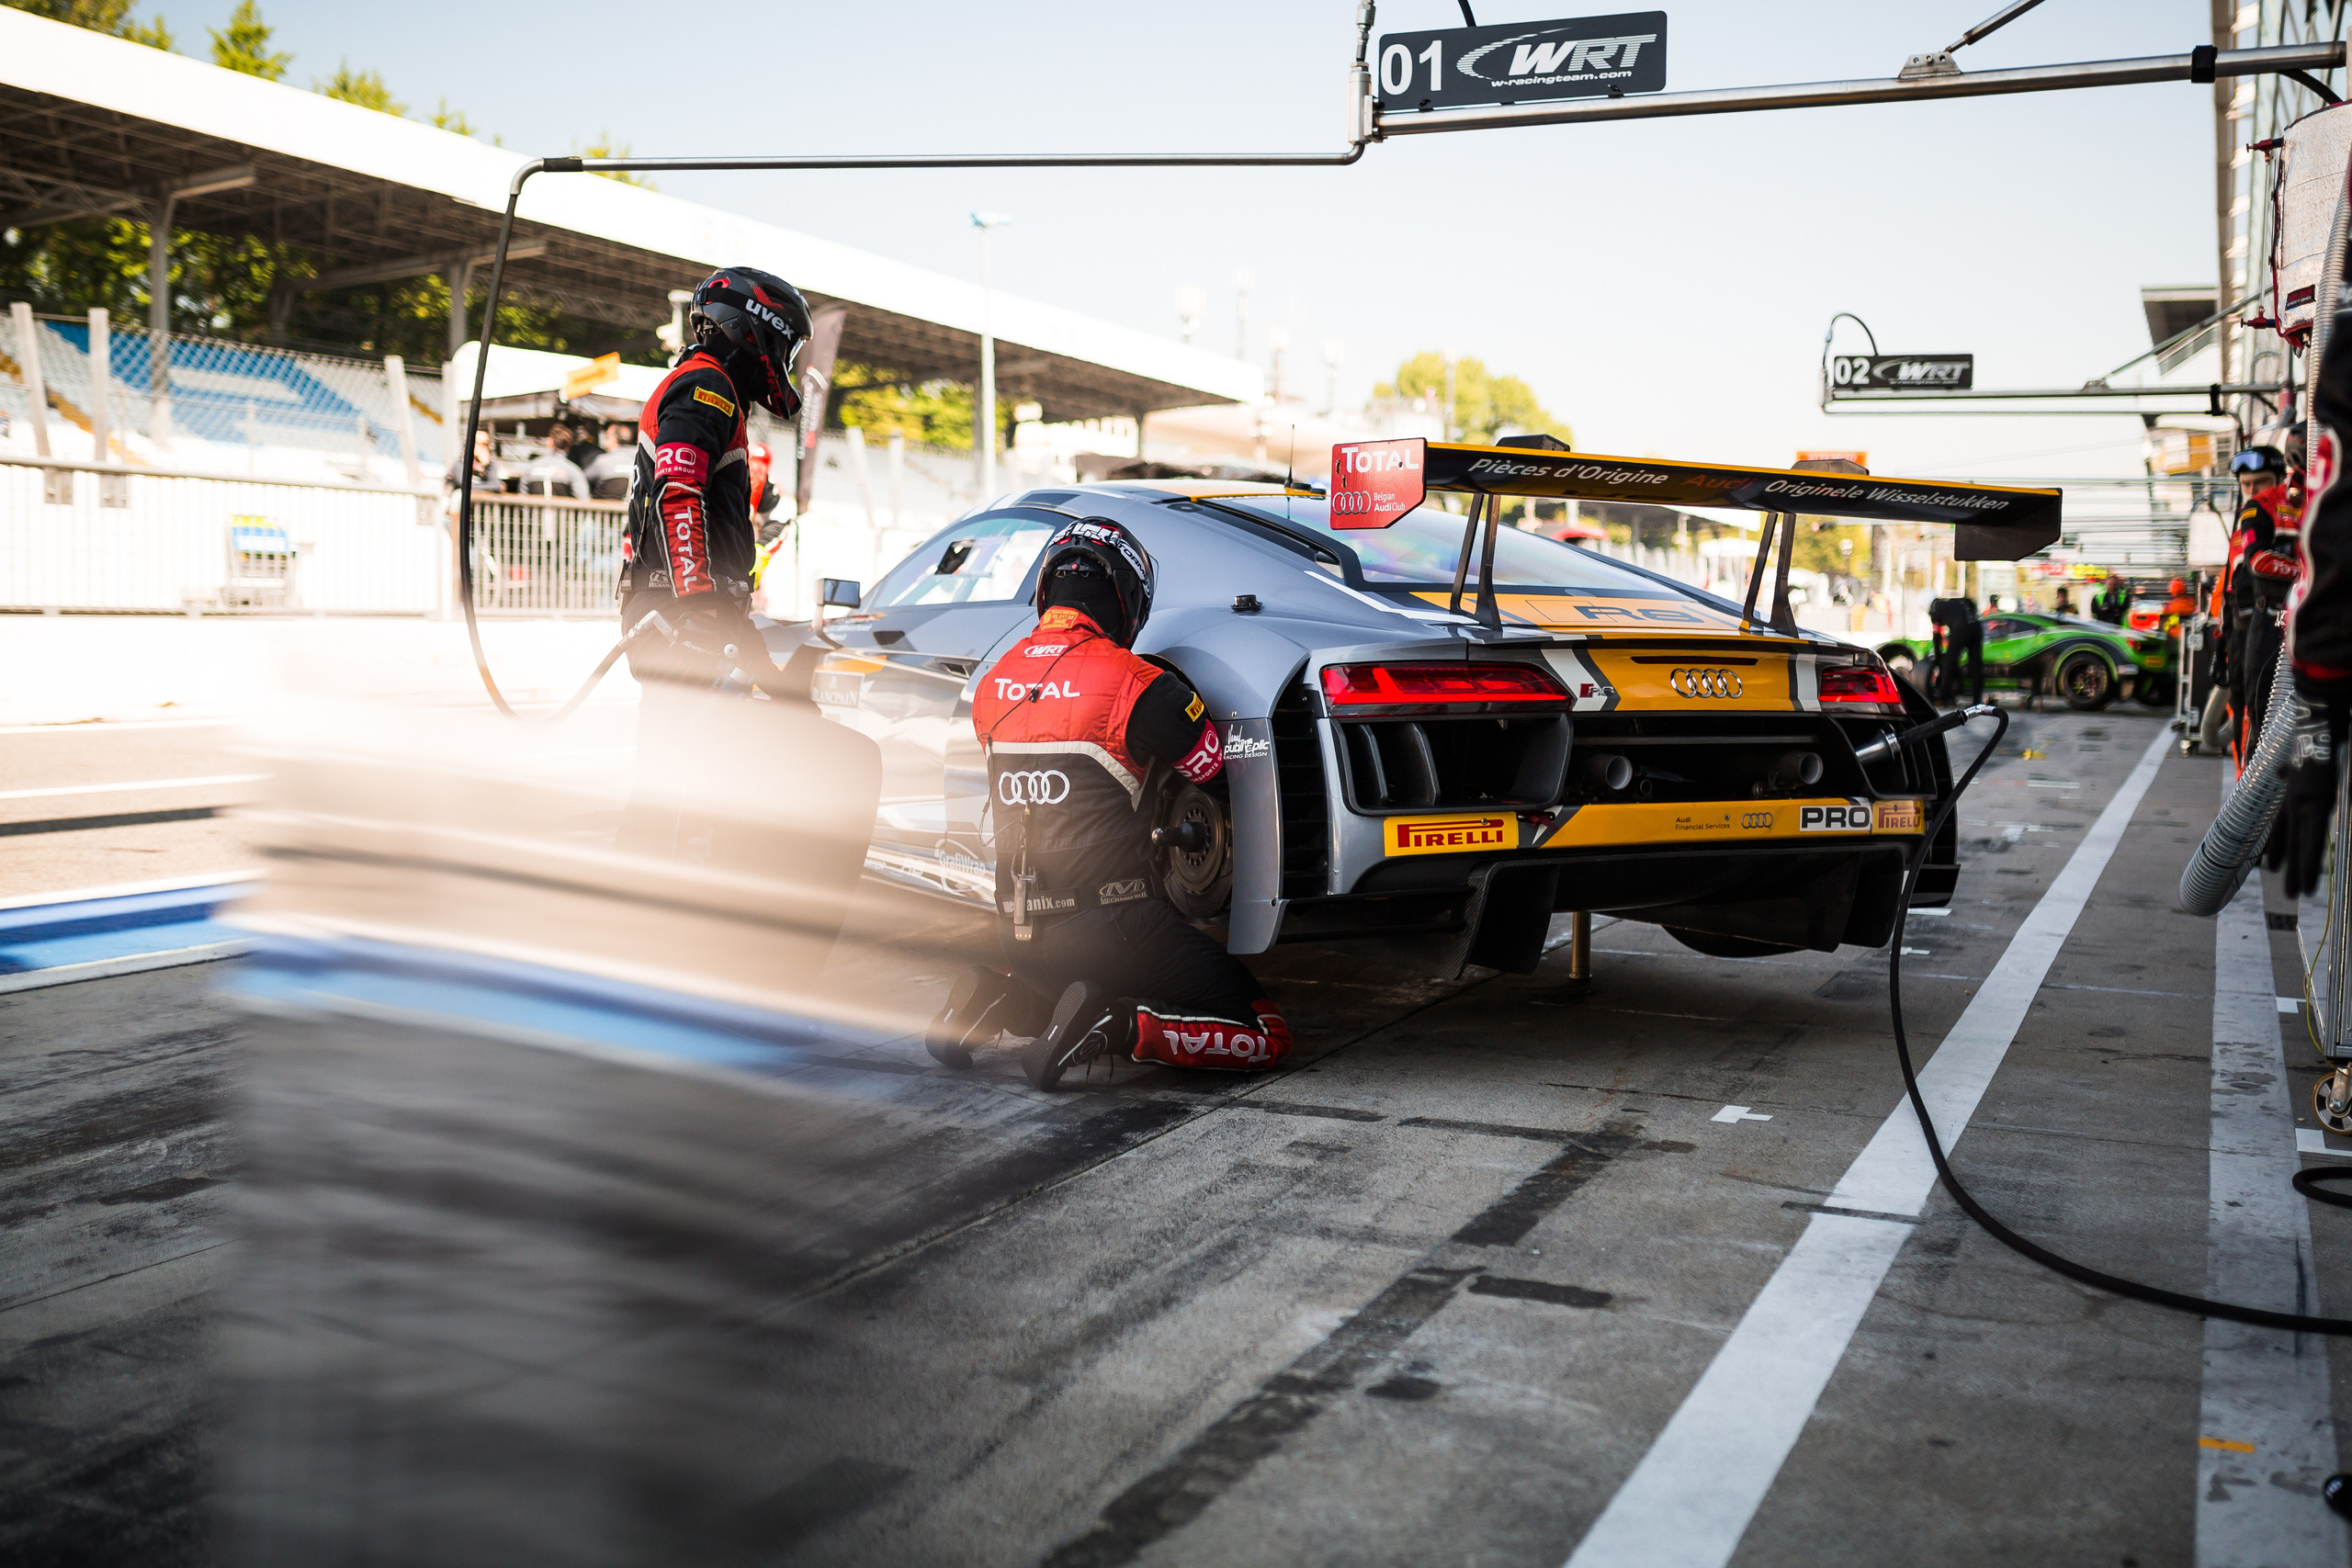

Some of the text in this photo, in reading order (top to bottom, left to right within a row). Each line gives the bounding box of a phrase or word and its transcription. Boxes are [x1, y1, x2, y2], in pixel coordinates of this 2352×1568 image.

[1380, 34, 1657, 95] 01 WRT
[1491, 70, 1633, 87] w-racingteam.com
[745, 299, 796, 341] uvex
[1835, 356, 1971, 385] 02 WRT
[673, 466, 695, 474] GROUP
[1340, 446, 1420, 474] TOTAL
[1467, 458, 1669, 486] Pièces d'Origine
[1679, 474, 1758, 490] Audi
[1374, 492, 1396, 503] Belgian
[1764, 479, 2010, 512] Originele Wisselstukken
[1374, 502, 1407, 513] Audi Club
[673, 506, 698, 592] TOTAL
[1573, 604, 1705, 624] R8
[1030, 645, 1069, 657] WRT
[994, 678, 1080, 701] TOTAL
[1802, 807, 1871, 829] PRO
[1879, 807, 1921, 829] PIRELLI
[1397, 818, 1505, 848] PIRELLI
[939, 851, 986, 877] GrafiWrap
[1002, 896, 1076, 913] meanix.com
[1161, 1030, 1272, 1064] TOTAL
